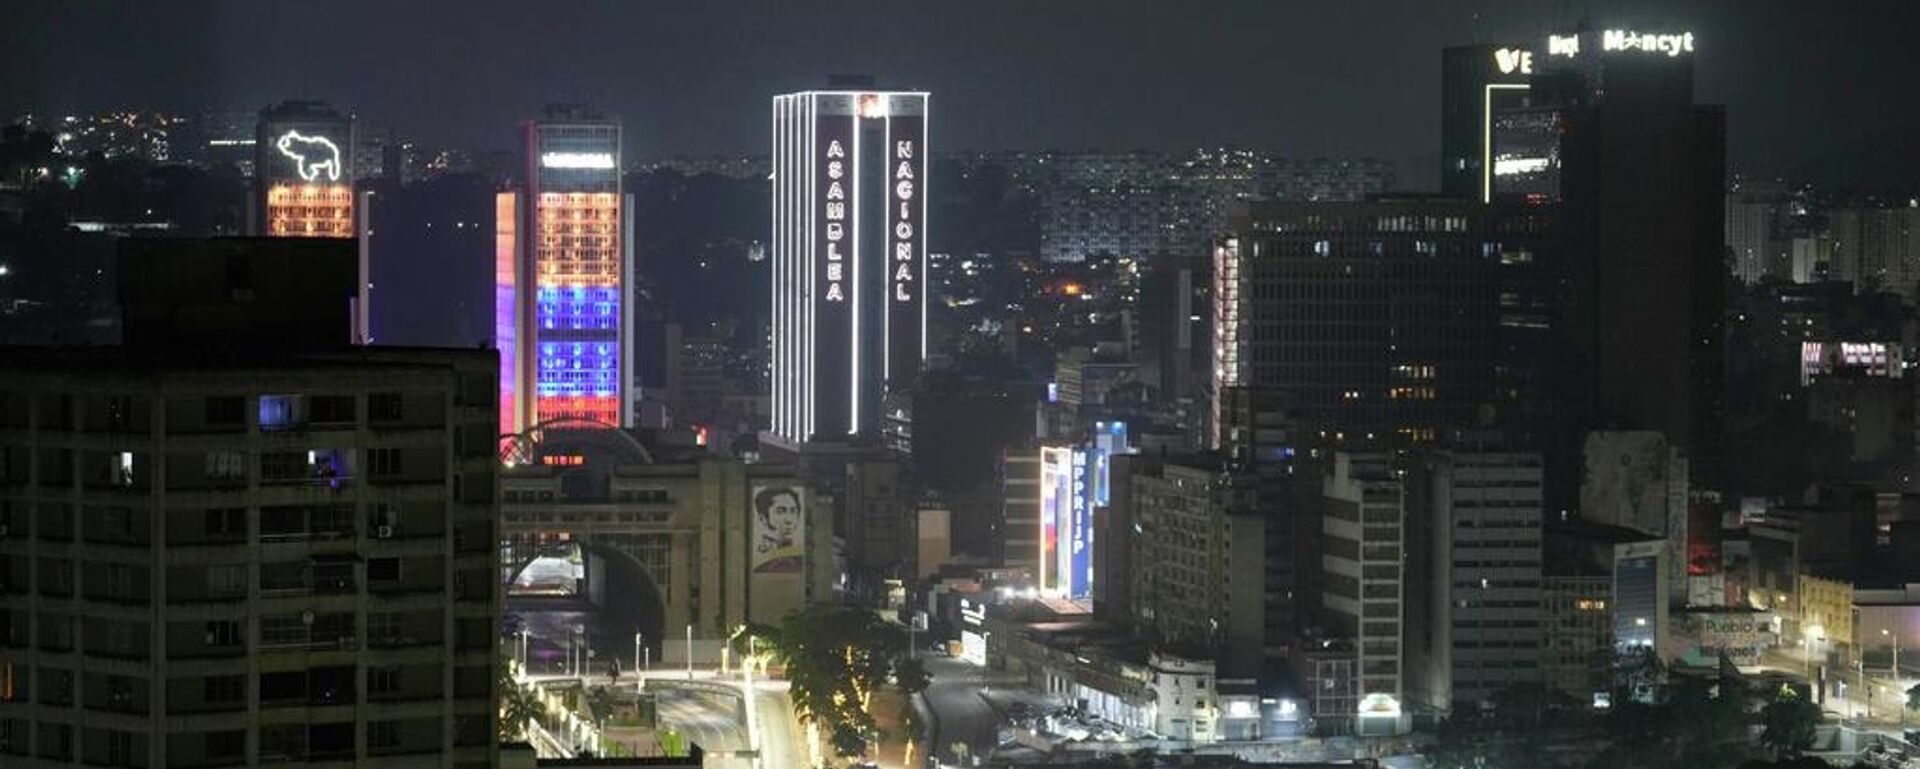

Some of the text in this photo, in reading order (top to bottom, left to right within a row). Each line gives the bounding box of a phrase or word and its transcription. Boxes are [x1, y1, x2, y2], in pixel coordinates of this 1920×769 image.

[826, 140, 845, 300] ASAMBLEA
[896, 141, 913, 300] NACIONAL
[1073, 451, 1086, 555] MPPRIJP
